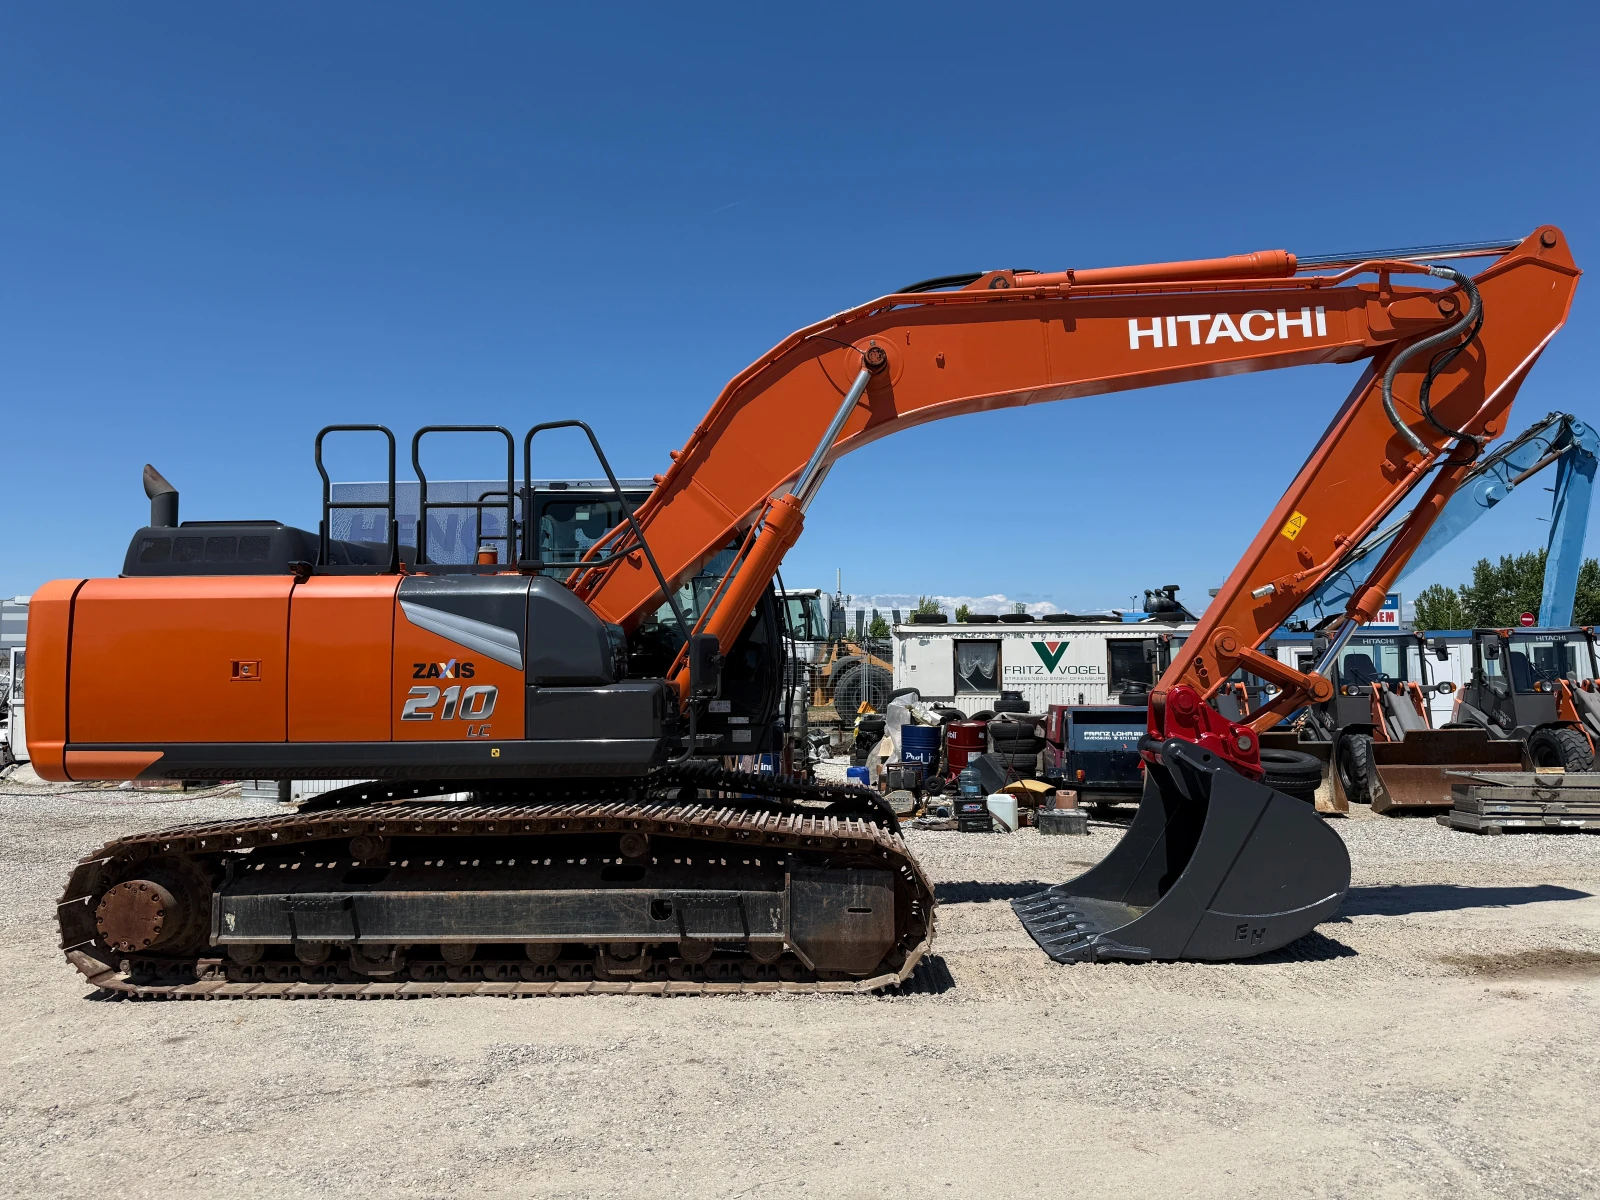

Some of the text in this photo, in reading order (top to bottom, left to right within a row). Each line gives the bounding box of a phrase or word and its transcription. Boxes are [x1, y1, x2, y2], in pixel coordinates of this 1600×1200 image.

[1128, 305, 1327, 350] HITACHI
[350, 513, 523, 551] HENG
[412, 658, 475, 679] ZAXIS
[1004, 665, 1044, 675] FRITZ
[1058, 665, 1106, 675] VOGEL
[400, 685, 499, 721] 210
[466, 723, 492, 738] LC
